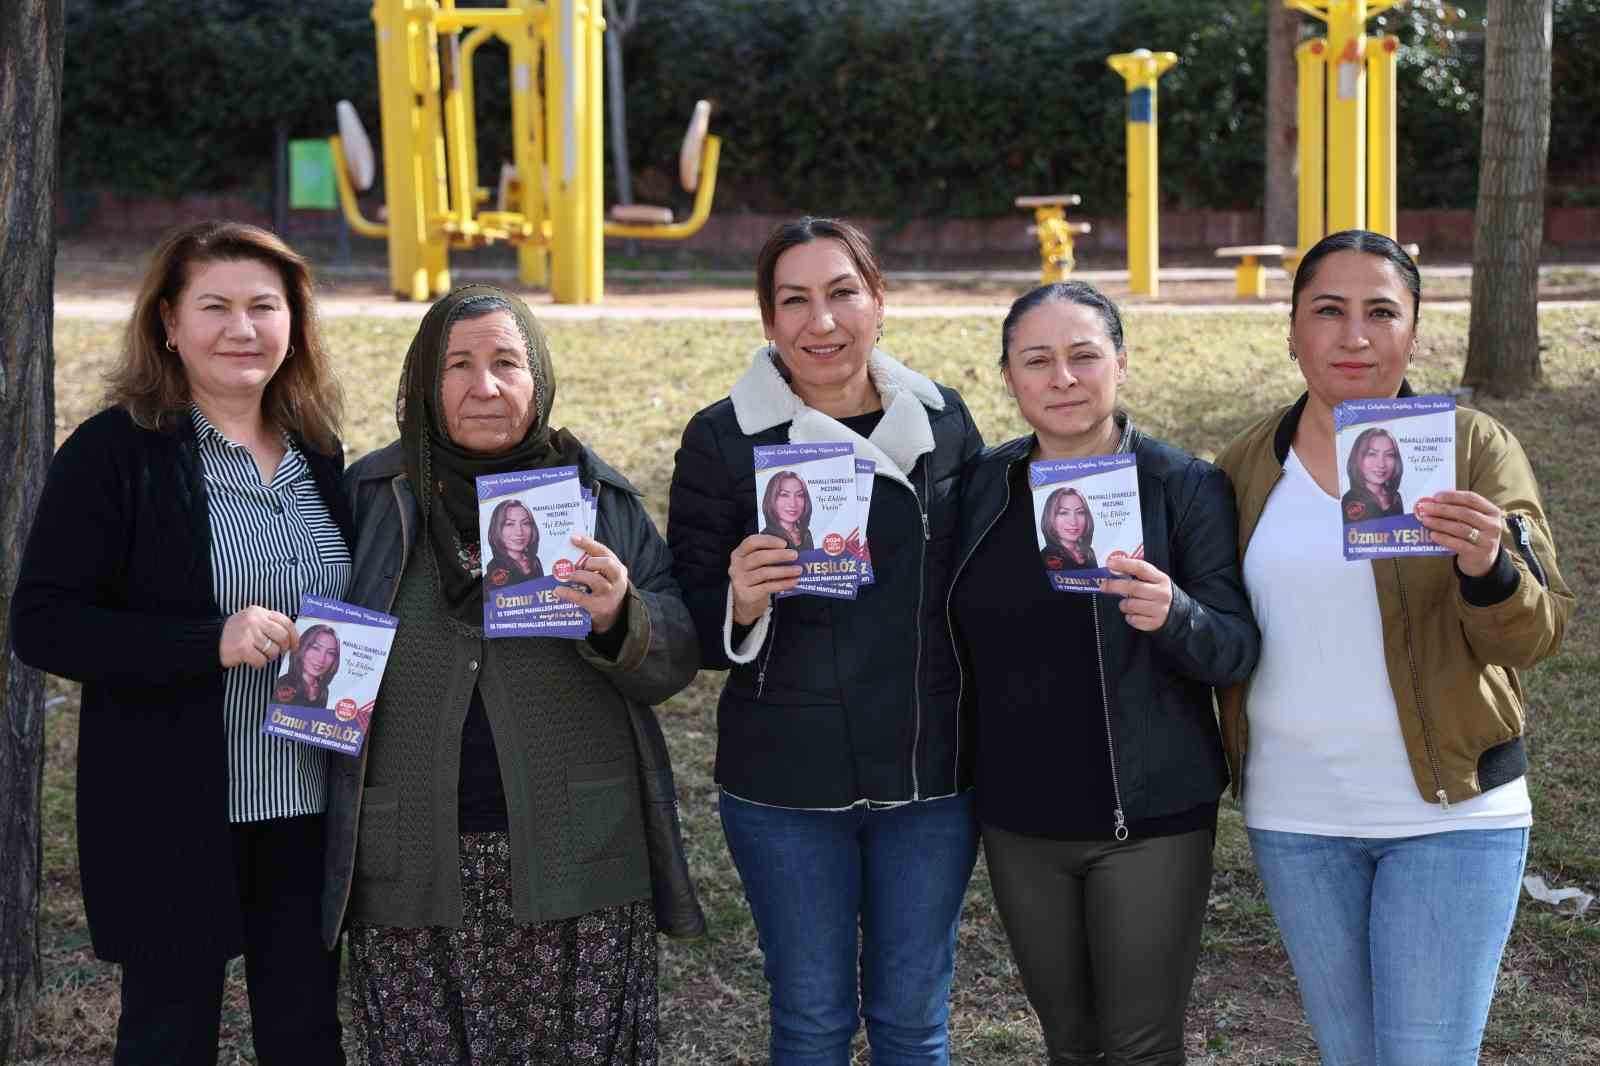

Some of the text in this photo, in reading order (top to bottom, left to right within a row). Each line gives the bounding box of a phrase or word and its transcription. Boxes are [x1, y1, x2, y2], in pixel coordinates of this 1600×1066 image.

[1348, 526, 1434, 545] Öznur YEŞİL
[805, 559, 857, 576] YEŞİLÖZ
[496, 592, 533, 609] Öznur
[272, 708, 361, 745] Öznur YEŞİLÖZ
